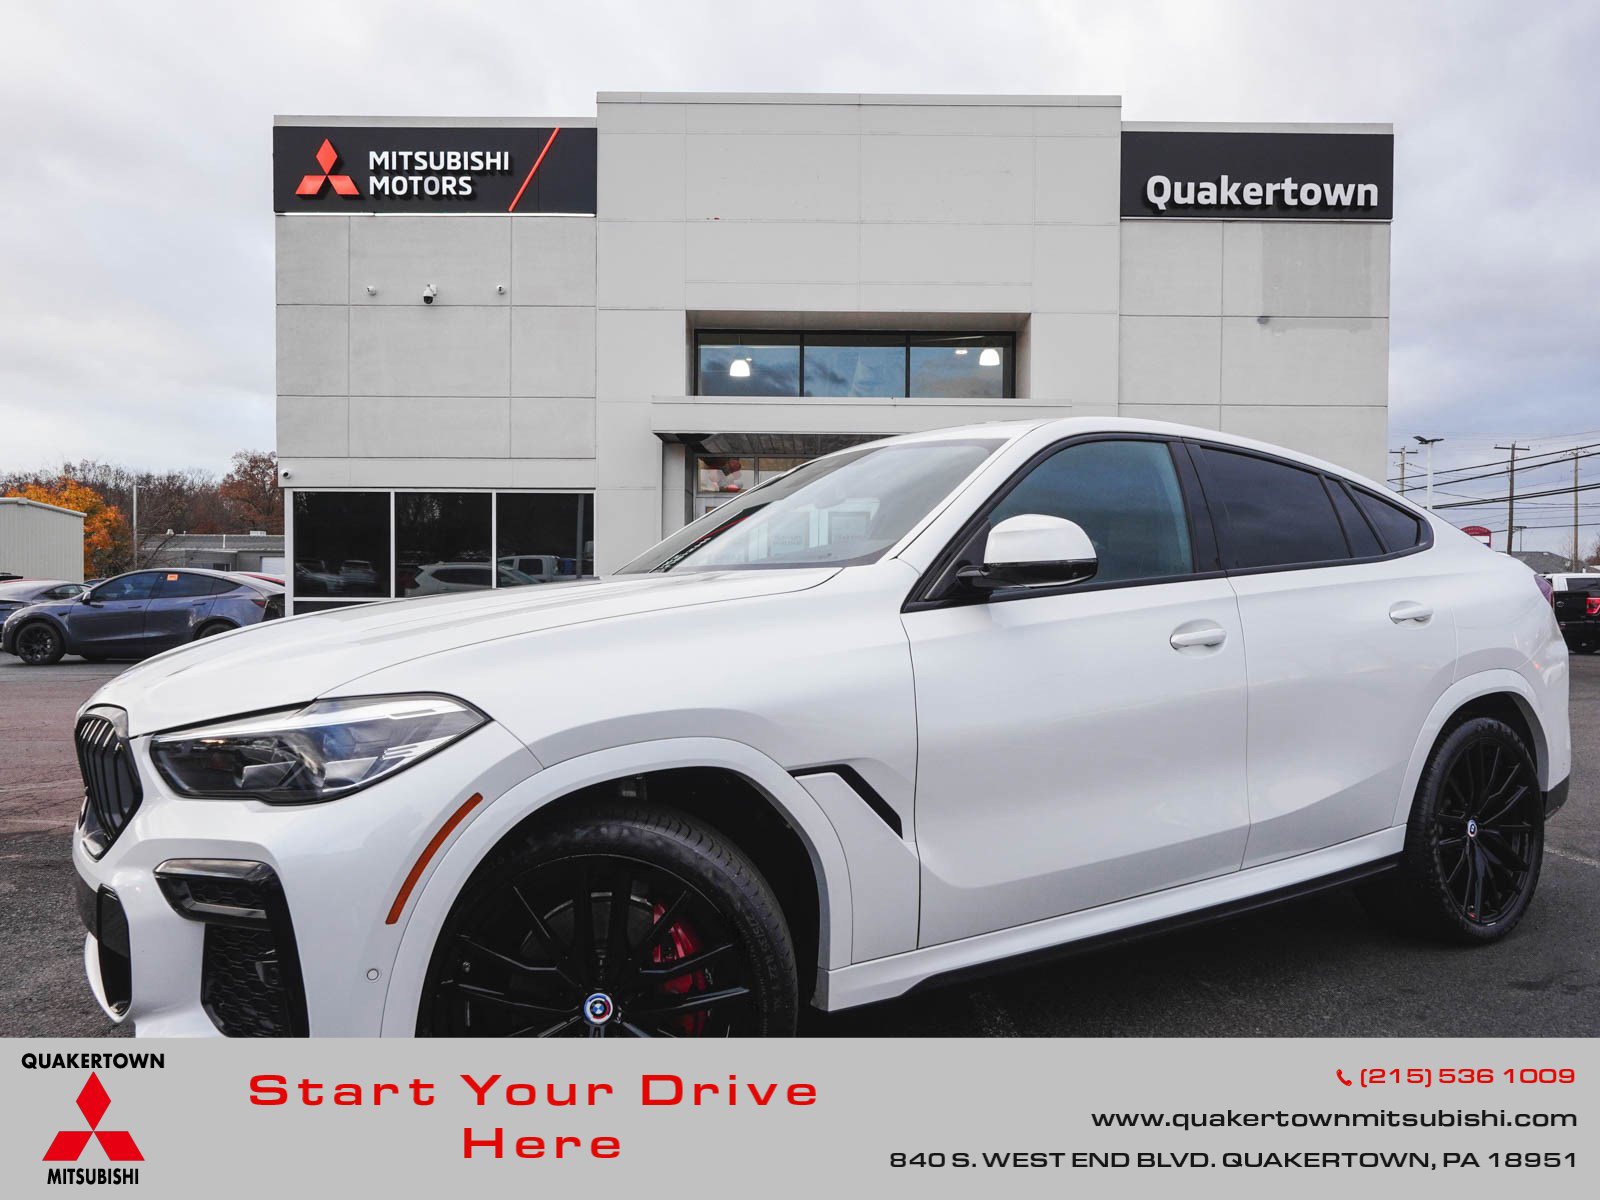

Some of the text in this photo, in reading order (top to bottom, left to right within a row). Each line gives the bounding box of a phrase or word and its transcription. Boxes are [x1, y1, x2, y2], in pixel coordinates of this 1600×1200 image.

[369, 150, 509, 171] MITSUBISHI
[369, 176, 472, 196] MOTORS
[1146, 174, 1378, 210] Quakertown
